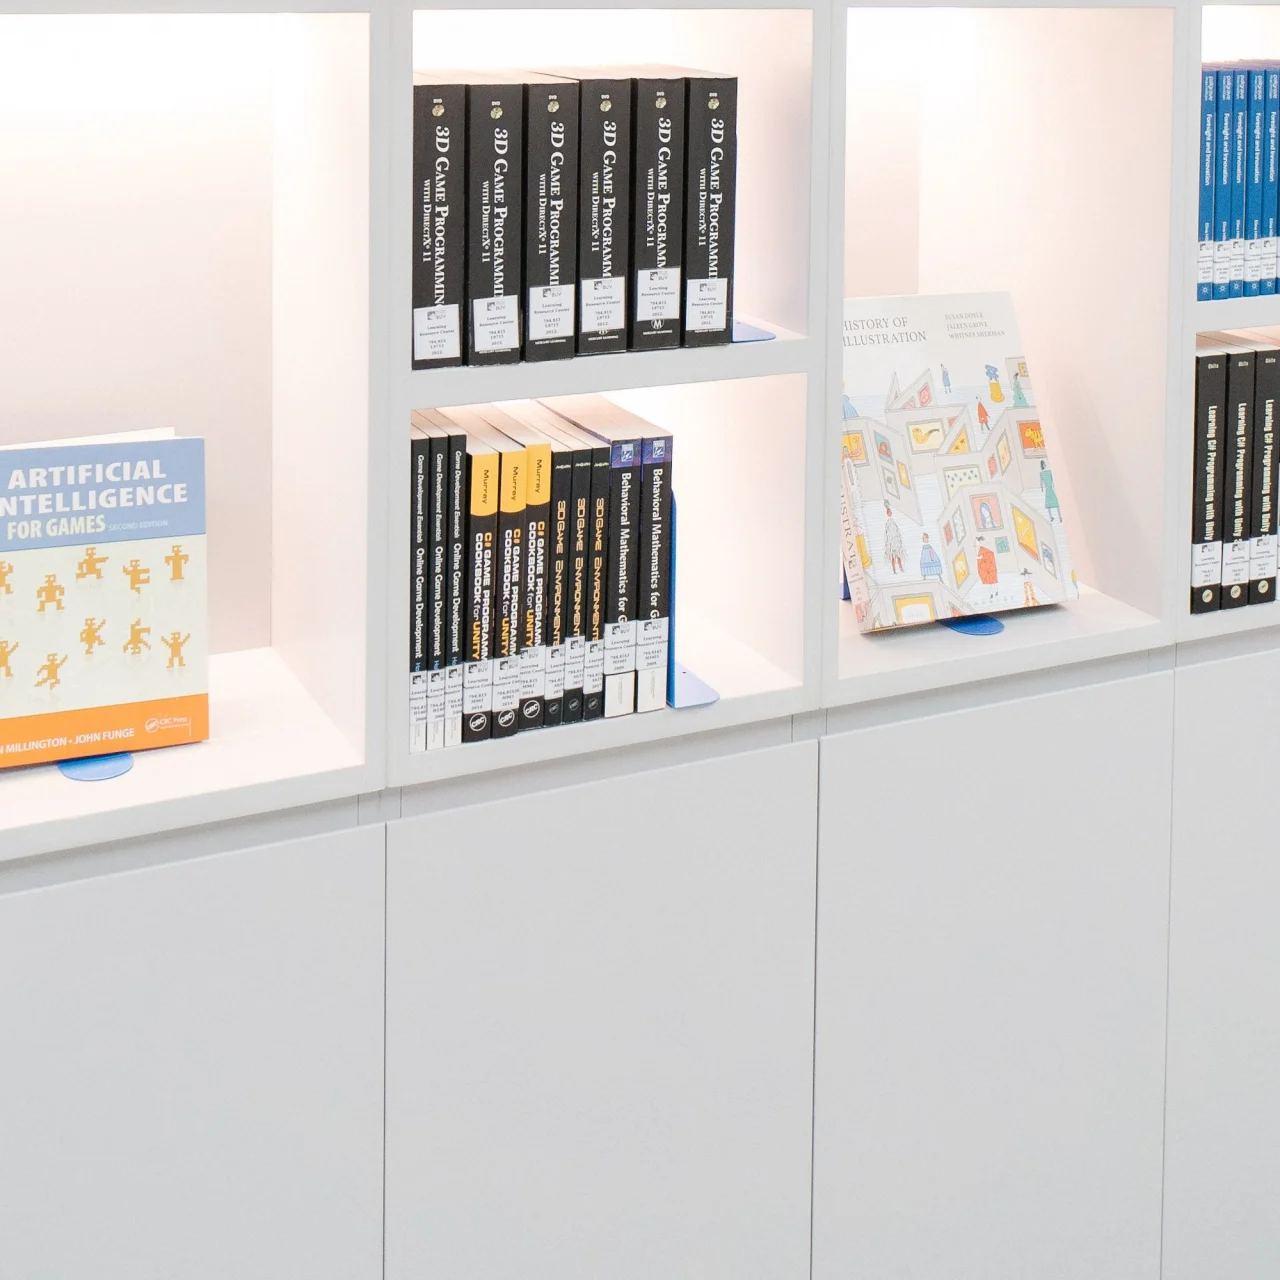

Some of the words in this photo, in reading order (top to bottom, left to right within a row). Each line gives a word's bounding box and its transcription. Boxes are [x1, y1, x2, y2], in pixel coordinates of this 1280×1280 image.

[435, 126, 449, 152] 3D
[423, 251, 431, 262] 11
[434, 205, 449, 307] PROGRAMMIN
[843, 331, 927, 347] ILLUSTRATION
[892, 317, 908, 328] OF
[7, 459, 167, 490] ARTIFICIAL
[482, 469, 490, 504] Murray
[620, 472, 631, 528] Behavioral
[7, 520, 42, 540] FOR
[45, 514, 106, 538] GAMES
[473, 532, 483, 603] COOKBOOK
[483, 549, 491, 586] GAME
[618, 529, 630, 594] Mathematics
[618, 597, 629, 612] for
[472, 621, 481, 660] UNITY
[480, 590, 490, 661] PROGRAMM
[5, 737, 67, 754] MILLINGTON
[73, 731, 100, 744] JOHN
[102, 728, 135, 740] FUNGE
